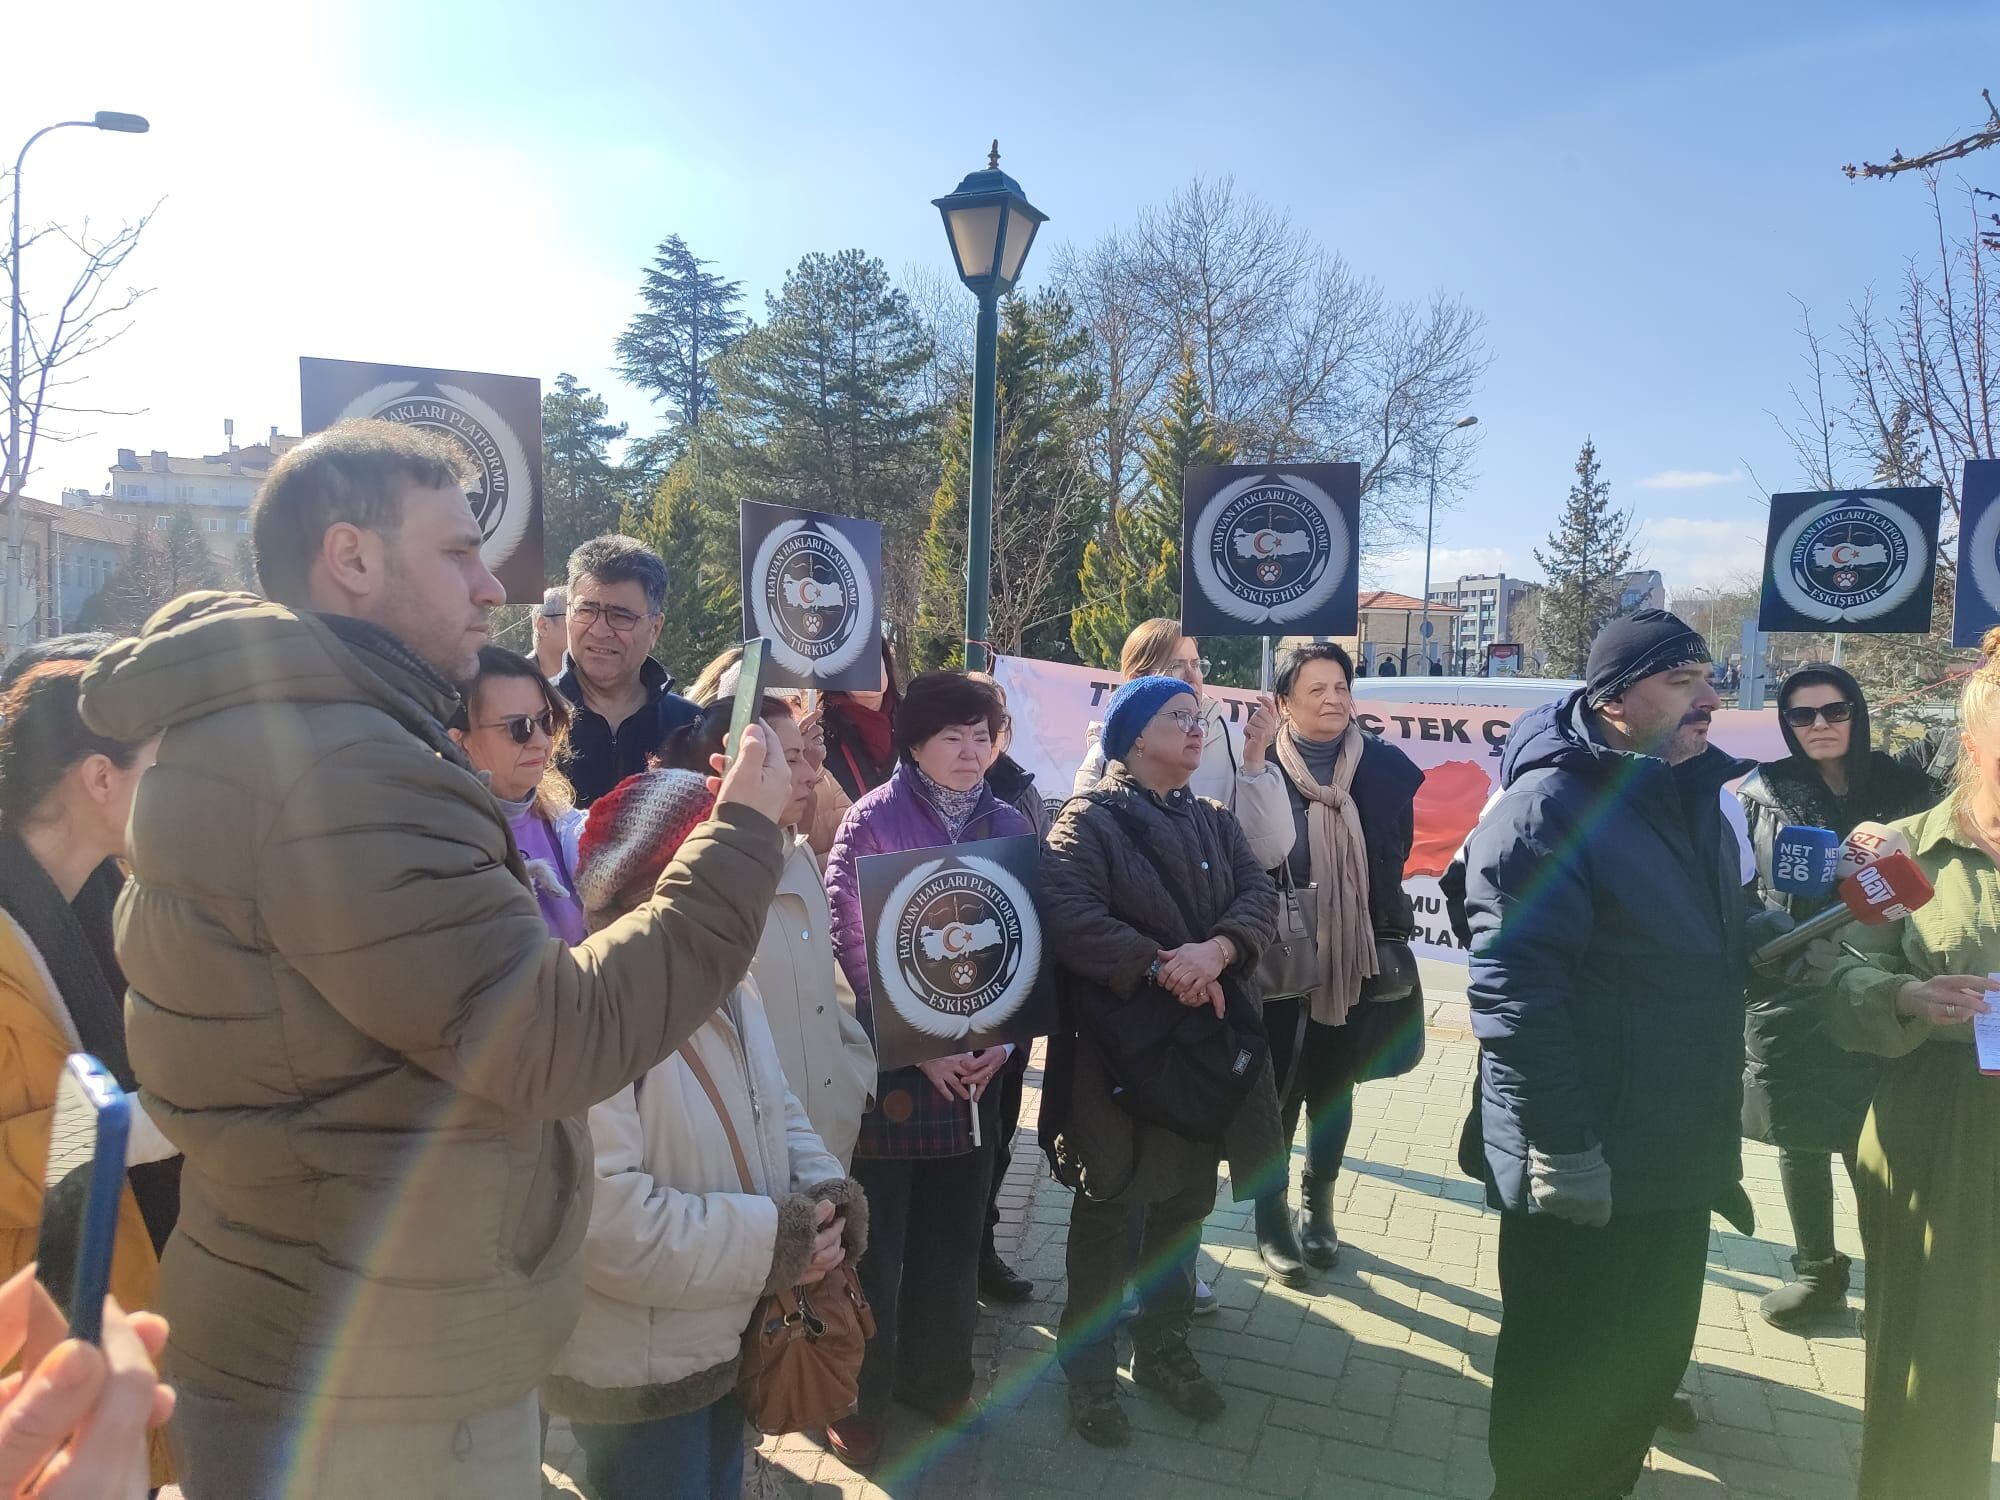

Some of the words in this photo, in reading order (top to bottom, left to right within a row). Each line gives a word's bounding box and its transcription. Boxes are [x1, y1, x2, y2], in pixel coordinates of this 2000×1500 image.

[383, 405, 447, 421] AKLARI
[449, 412, 505, 492] PLATFORMU
[1213, 510, 1237, 552] HAYVAN
[1235, 490, 1286, 512] HAKLARI
[1287, 494, 1329, 551] PLATFORMU
[1792, 527, 1815, 563] HAYVAN
[1815, 511, 1865, 530] HAKLARI
[1866, 513, 1906, 561] PLATFORMU
[768, 553, 785, 598] HAYVAN
[782, 538, 822, 556] HAKLARI
[823, 544, 857, 605] PLATFORMU
[1233, 583, 1306, 605] ESKİŞEHİR
[1809, 588, 1881, 608] ESKİŞEHİR
[790, 636, 838, 656] TÜRKİYE
[1391, 716, 1472, 744] TEK
[1780, 843, 1813, 857] NET
[1851, 831, 1888, 849] GZT
[1843, 850, 1869, 865] 26
[1777, 862, 1809, 882] 26
[900, 905, 920, 959] HAYVAN
[916, 876, 968, 906] HAKLARI
[970, 877, 1020, 939] PLATFORMU
[929, 982, 1006, 1014] ESKİŞEHİR
